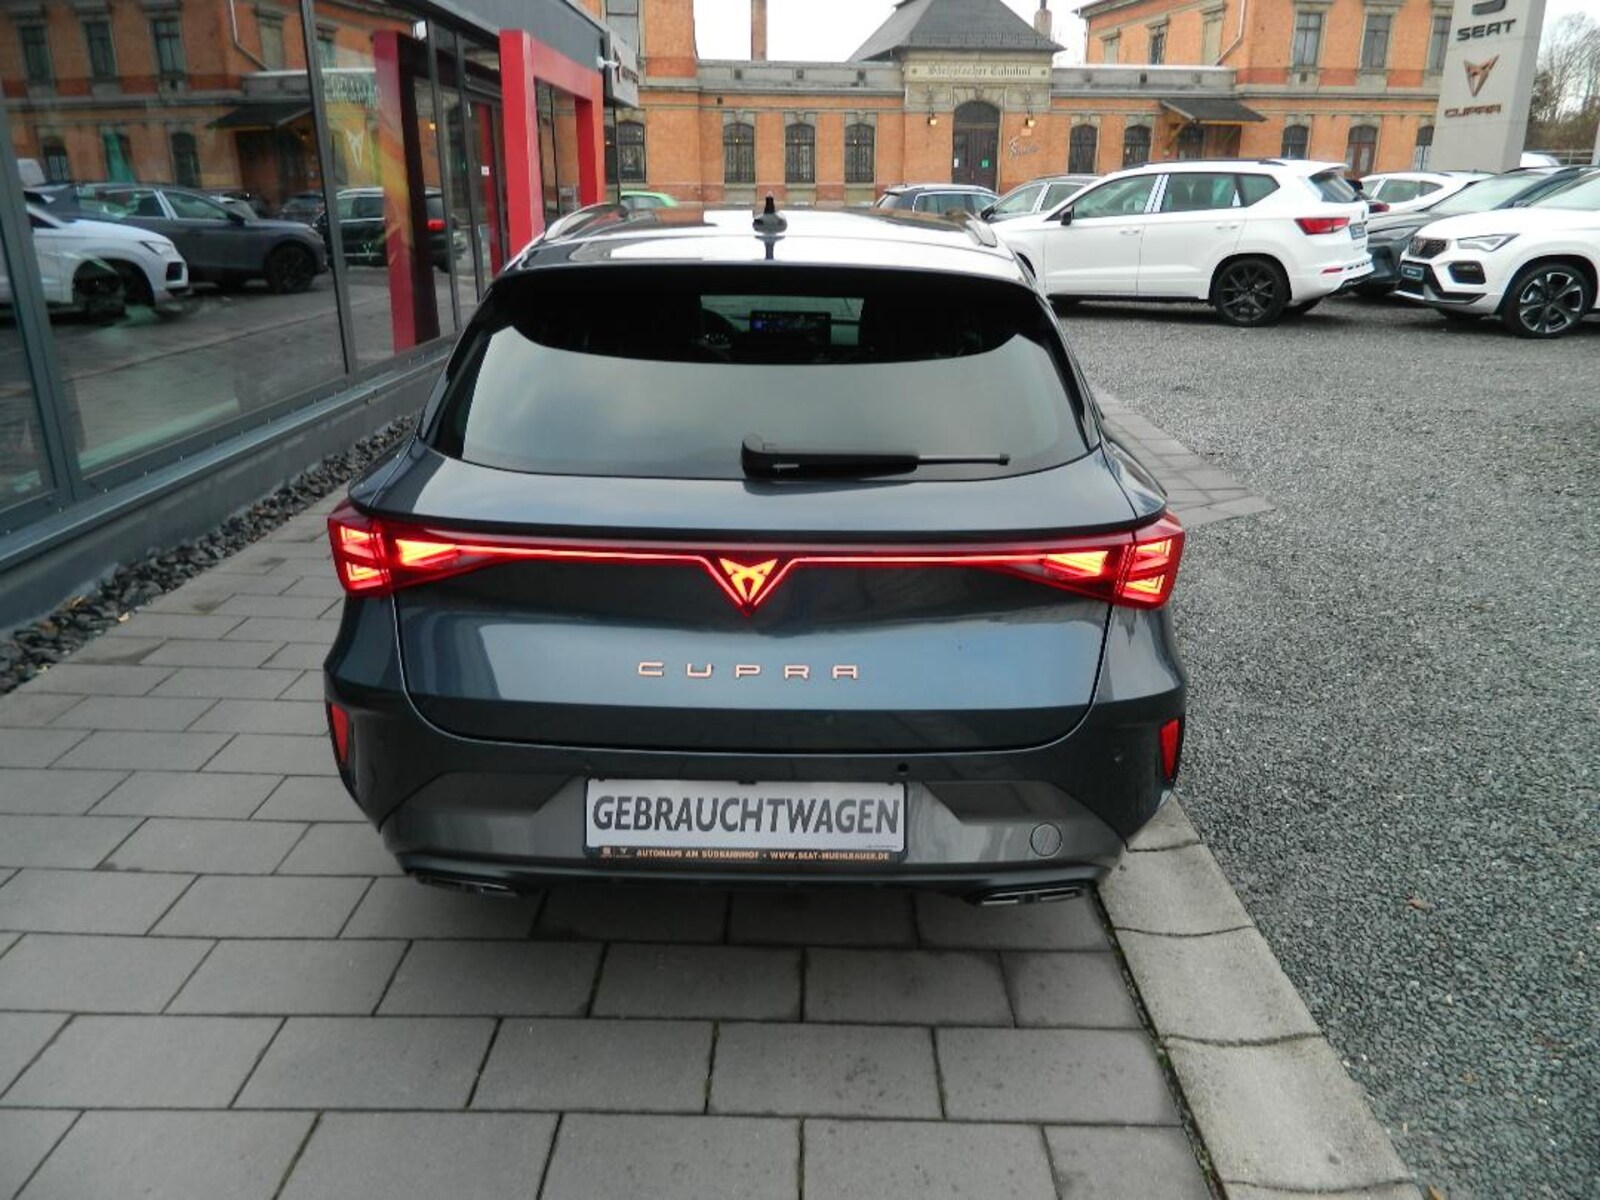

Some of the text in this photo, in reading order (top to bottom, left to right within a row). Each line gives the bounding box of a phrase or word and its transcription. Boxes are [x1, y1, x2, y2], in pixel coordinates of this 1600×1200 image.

[1457, 18, 1517, 41] SEAT
[1444, 103, 1502, 119] CUPRA
[637, 661, 859, 680] CUPRA
[592, 796, 901, 834] GEBRAUCHTWAGEN
[636, 848, 683, 858] AUTOHAUS
[686, 849, 699, 858] AM
